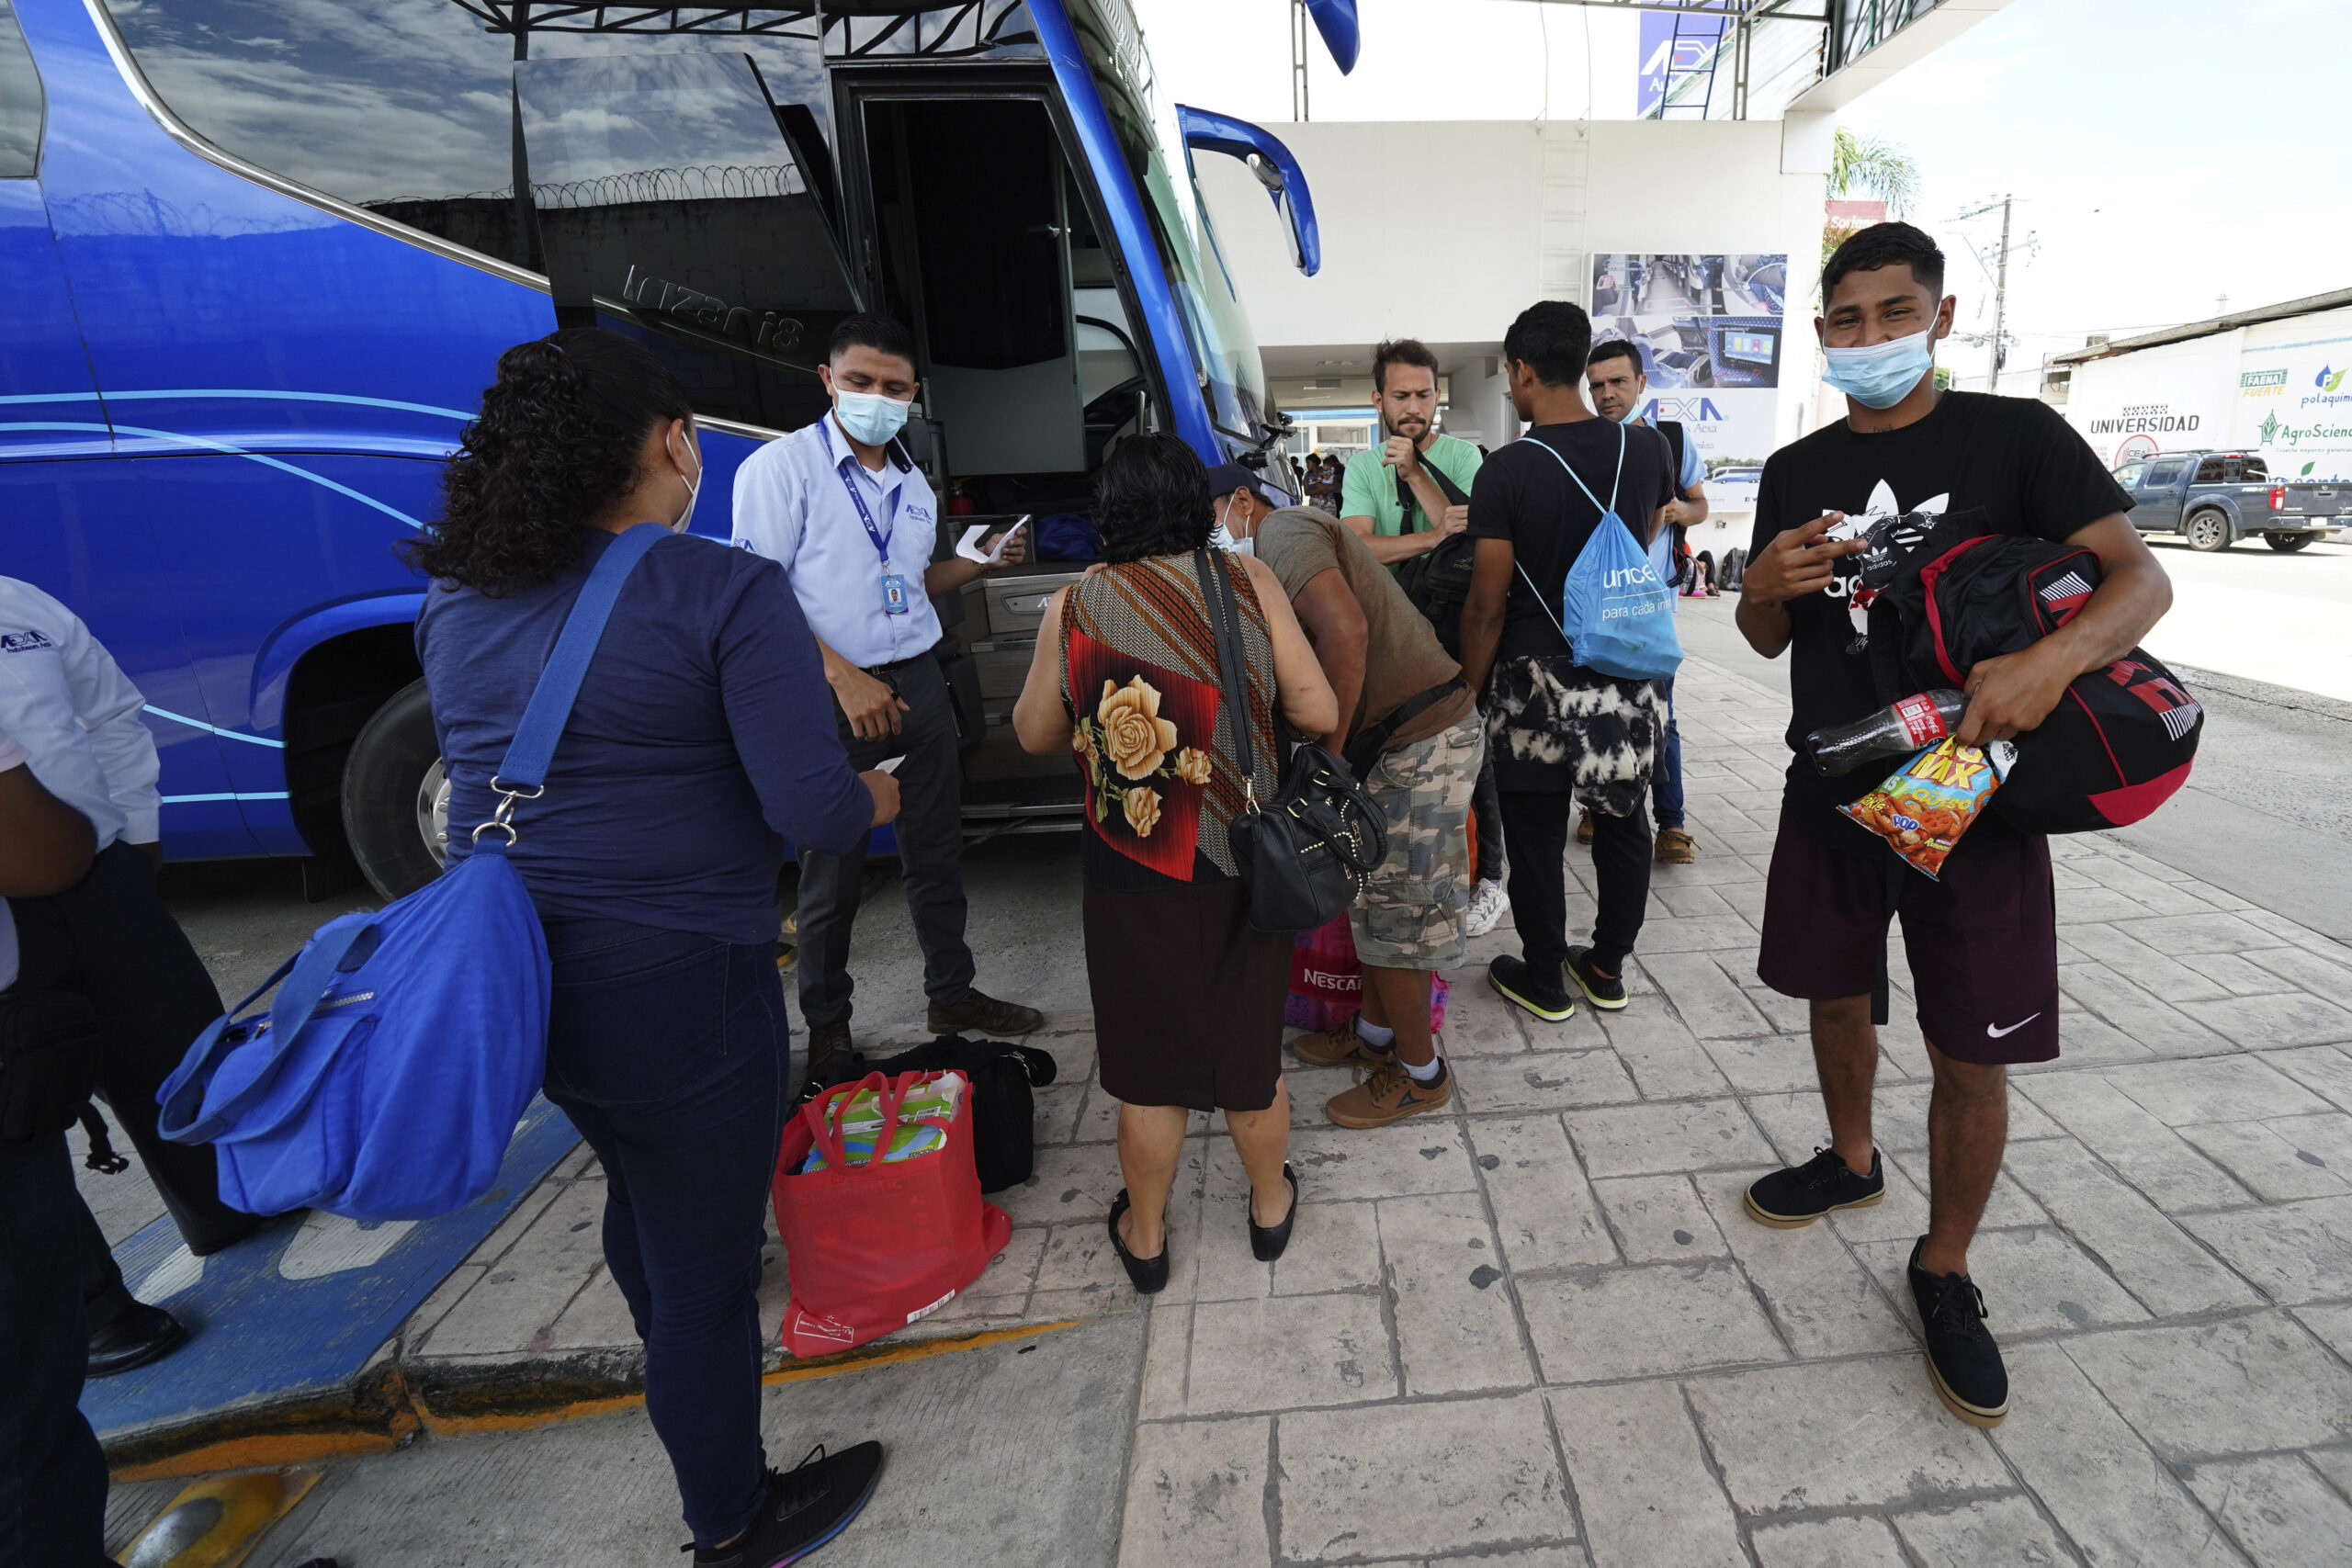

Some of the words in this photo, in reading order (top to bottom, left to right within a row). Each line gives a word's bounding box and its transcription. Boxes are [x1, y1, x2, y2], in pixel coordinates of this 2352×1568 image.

[2246, 374, 2278, 386] FAENA
[2243, 386, 2284, 397] FUERTE
[2090, 415, 2199, 434] UNIVERSIDAD
[1866, 558, 1893, 571] adidas
[1602, 606, 1628, 622] para
[1632, 601, 1656, 616] cada
[1910, 753, 1984, 789] MIX
[1893, 815, 1919, 831] POP
[1304, 968, 1363, 992] NESCAF
